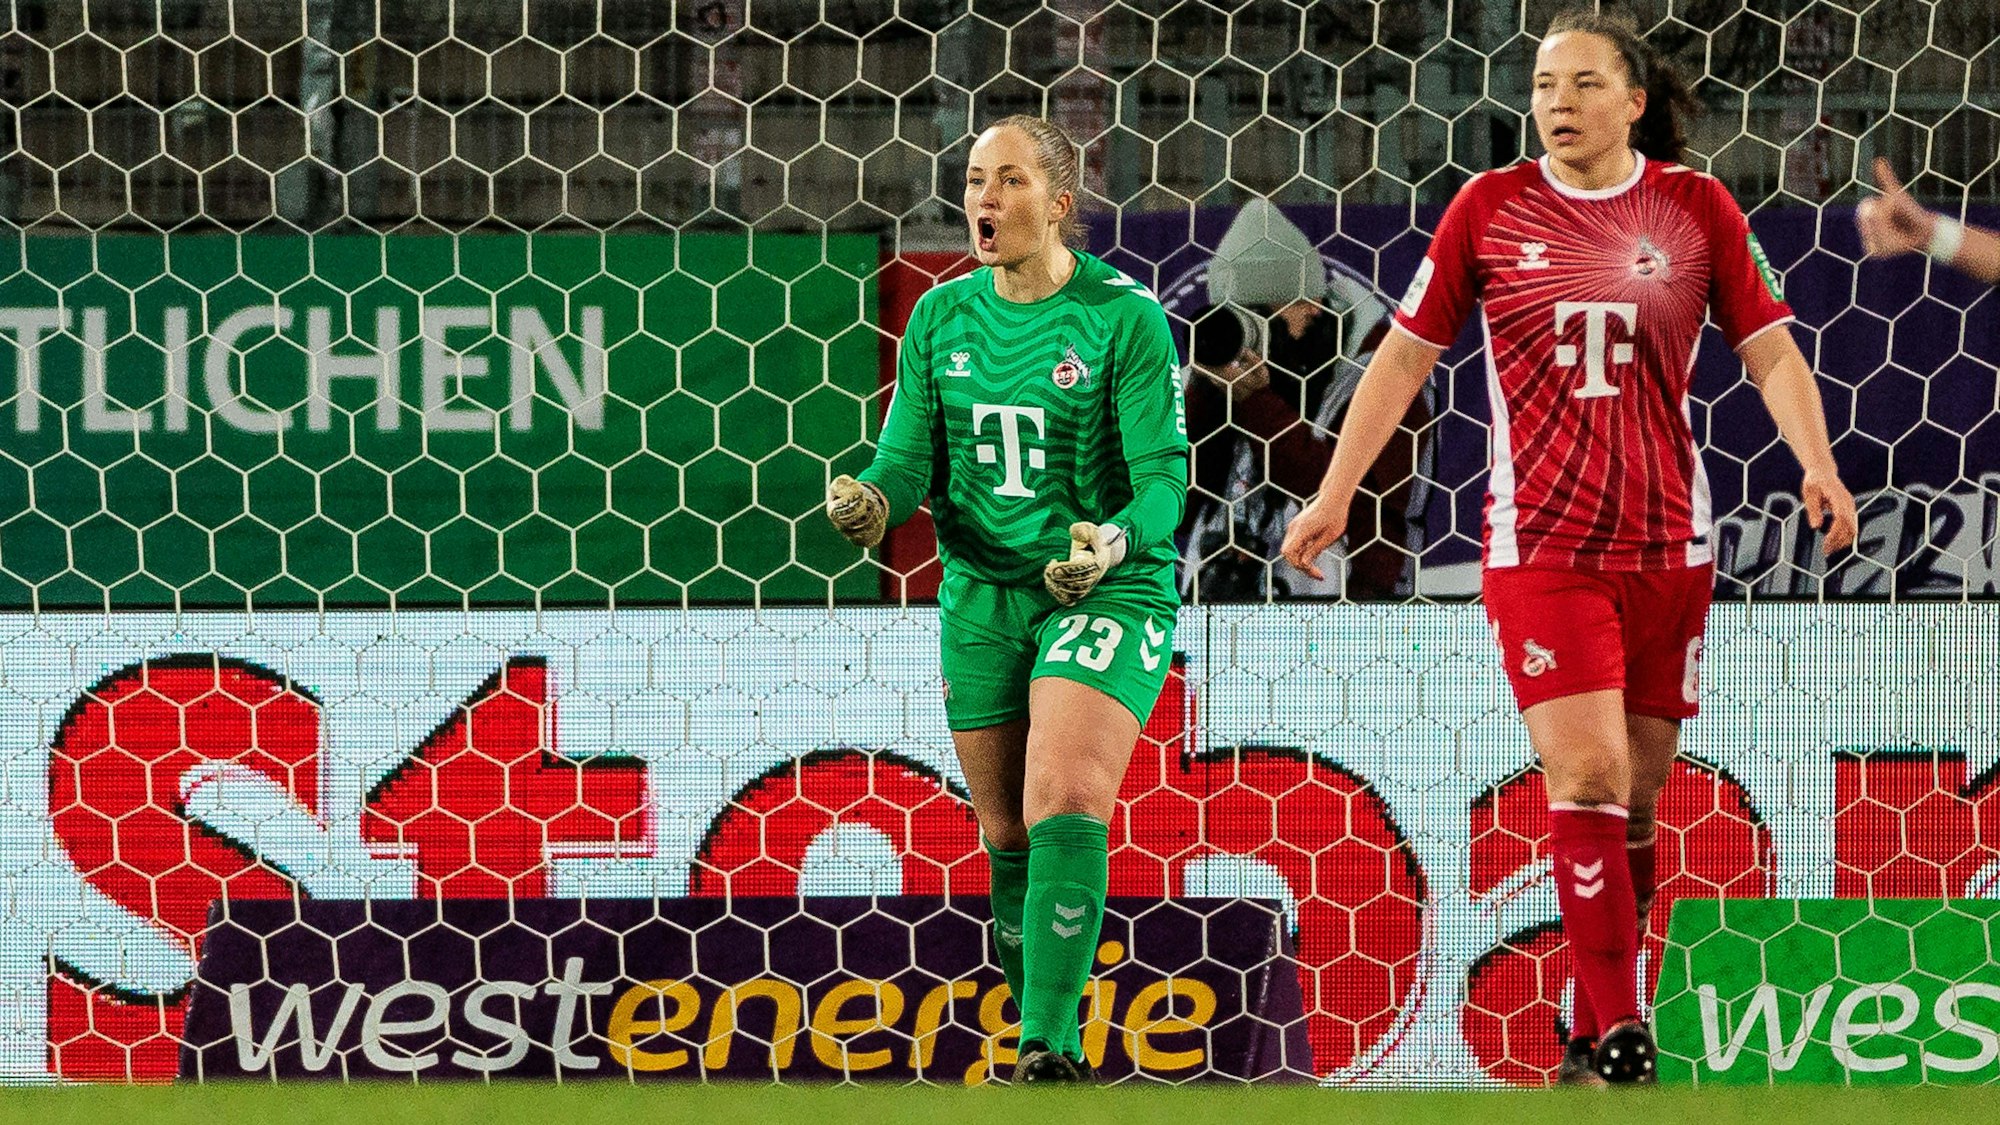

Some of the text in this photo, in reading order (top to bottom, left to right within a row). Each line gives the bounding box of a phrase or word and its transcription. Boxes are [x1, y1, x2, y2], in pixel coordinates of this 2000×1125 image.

[0, 307, 605, 432] TLICHEN
[1555, 301, 1637, 398] T
[972, 403, 1046, 498] T
[1044, 613, 1124, 673] 23
